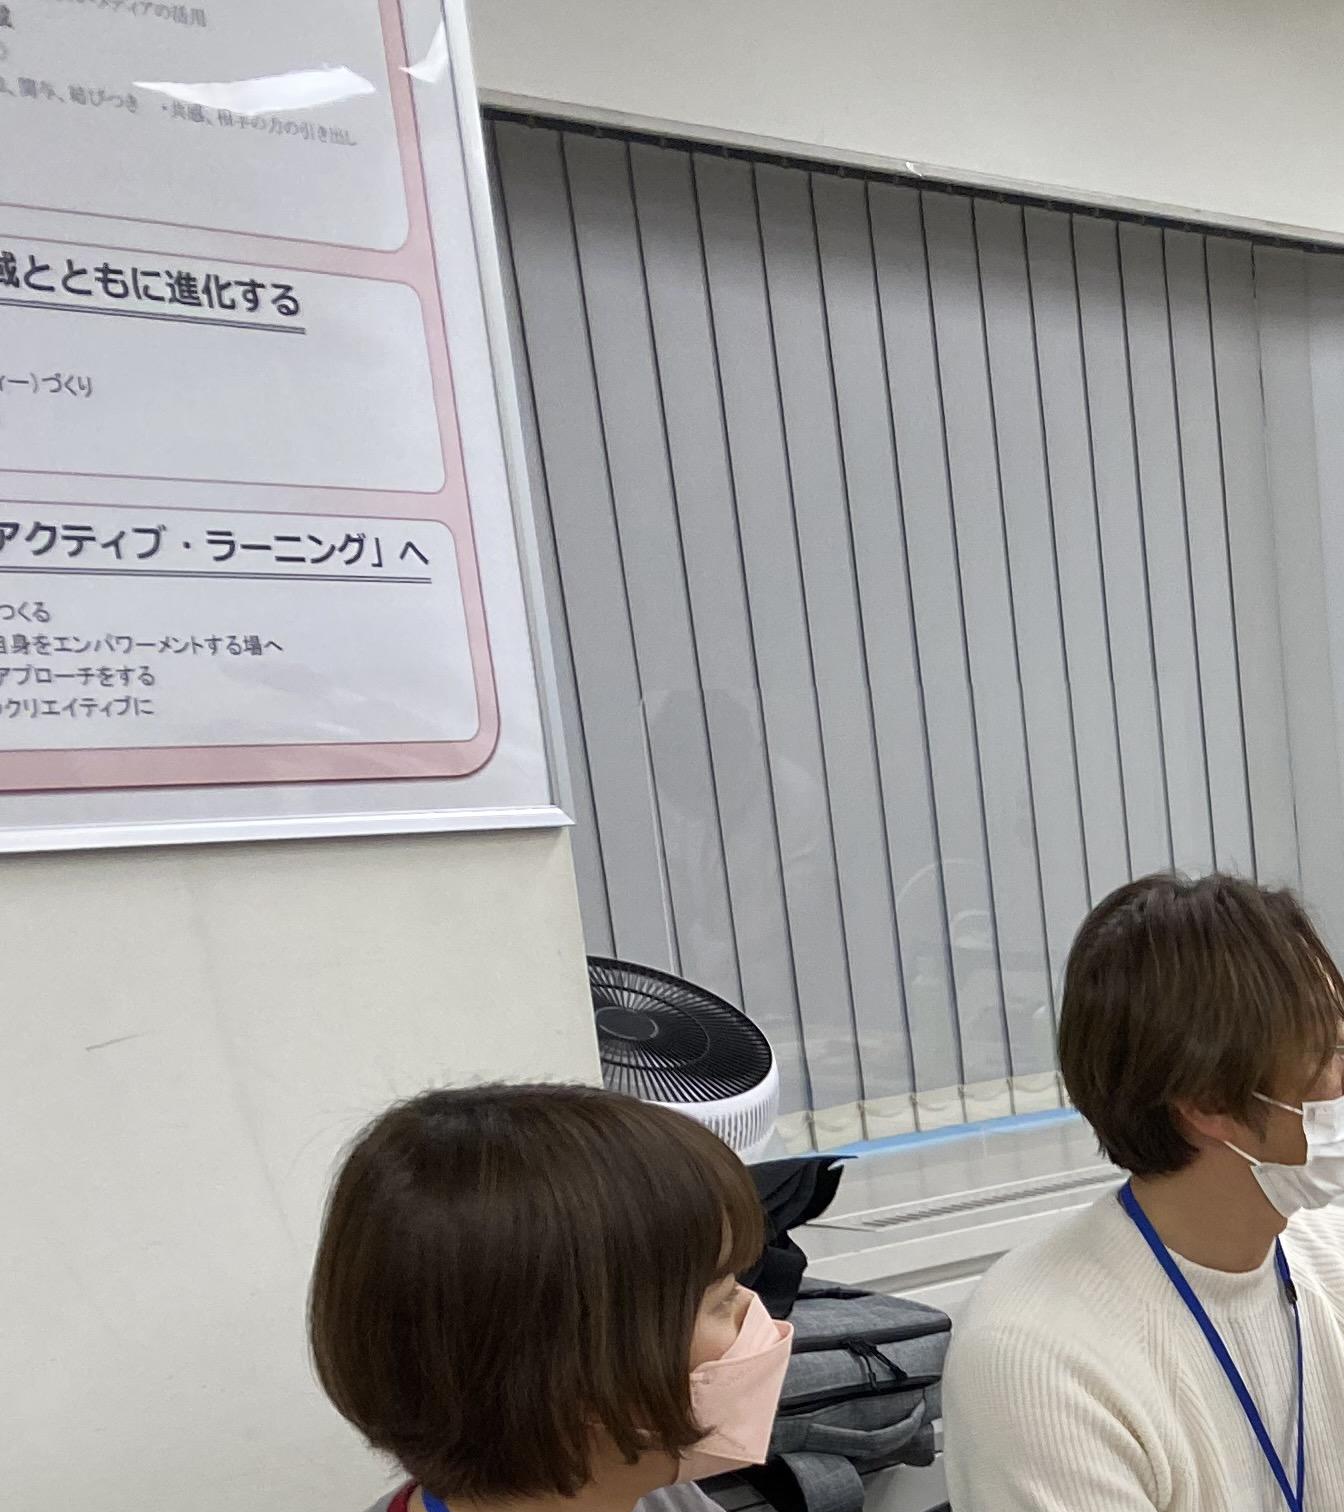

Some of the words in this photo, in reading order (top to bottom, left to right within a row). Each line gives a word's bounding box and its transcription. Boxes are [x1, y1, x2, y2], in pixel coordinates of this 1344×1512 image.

[0, 696, 155, 718] クリエイティブに
